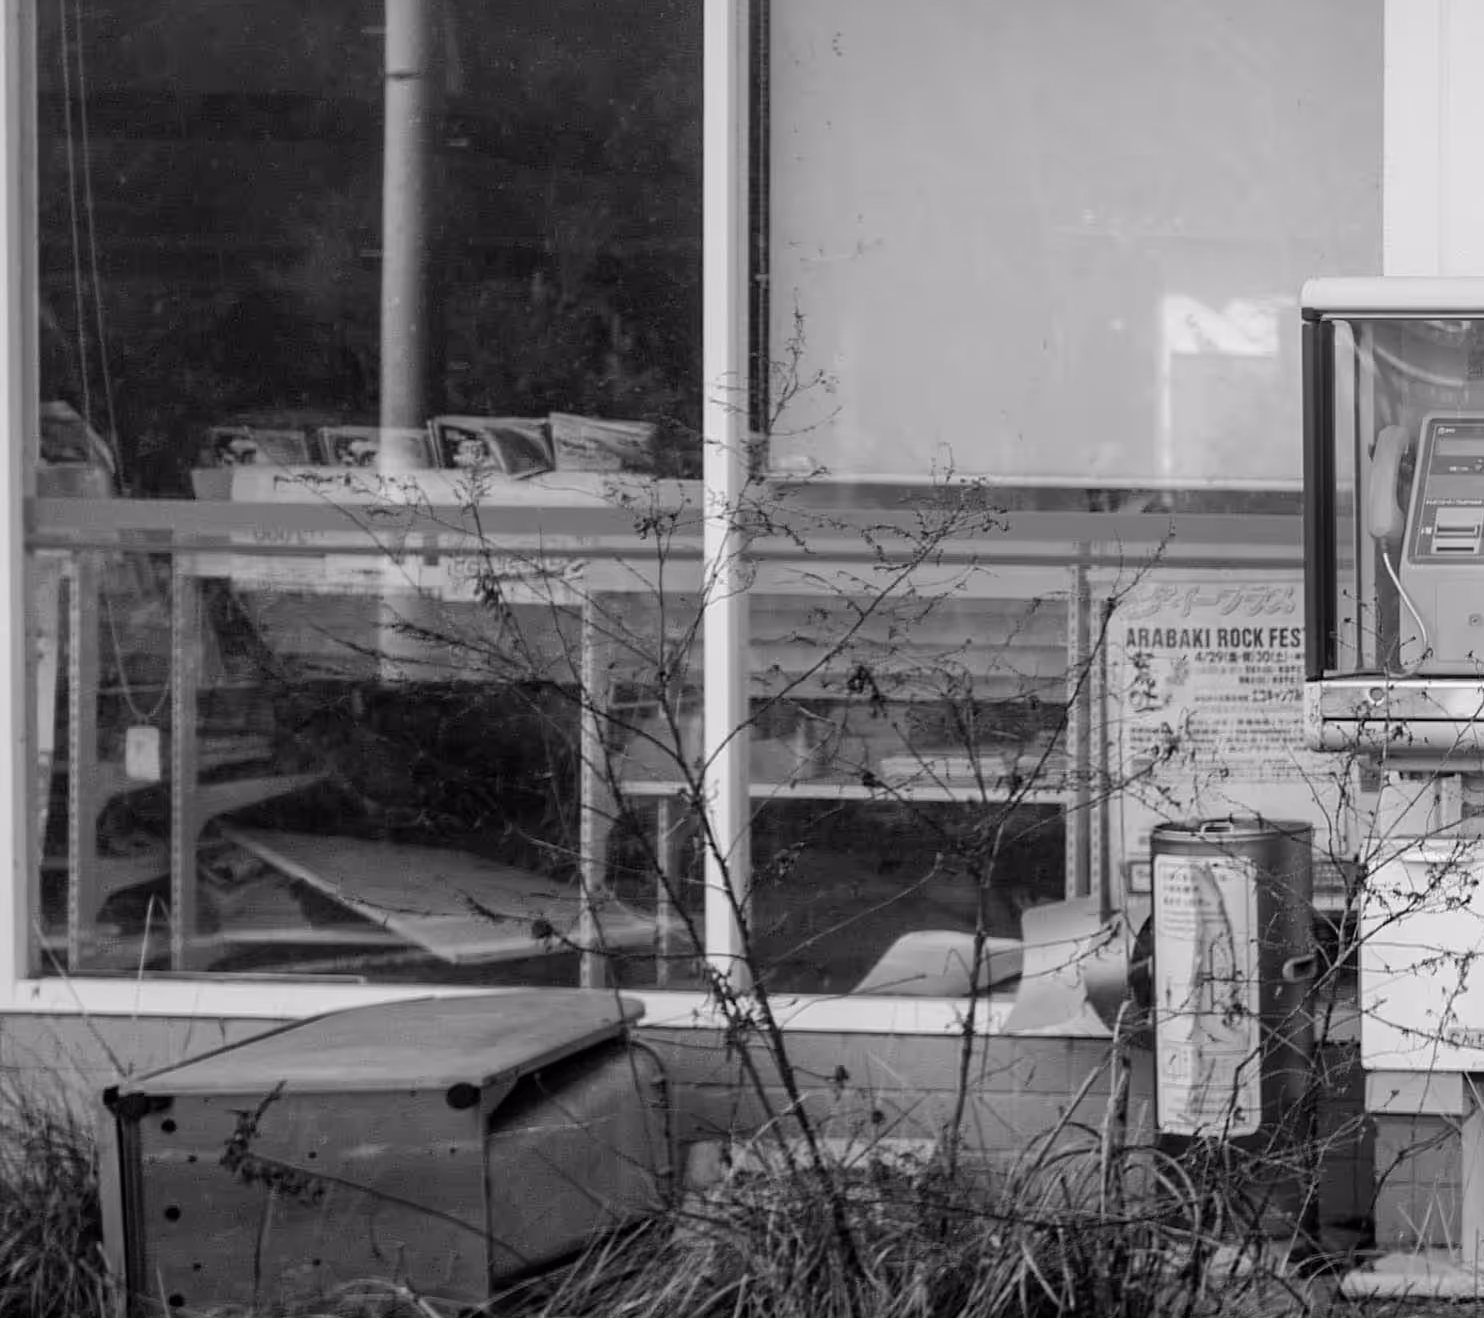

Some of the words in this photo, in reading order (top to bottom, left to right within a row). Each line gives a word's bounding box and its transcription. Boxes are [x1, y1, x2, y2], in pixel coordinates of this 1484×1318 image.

[1126, 627, 1211, 648] ARABAKI
[1218, 628, 1264, 648] ROCK
[1269, 627, 1306, 648] FES
